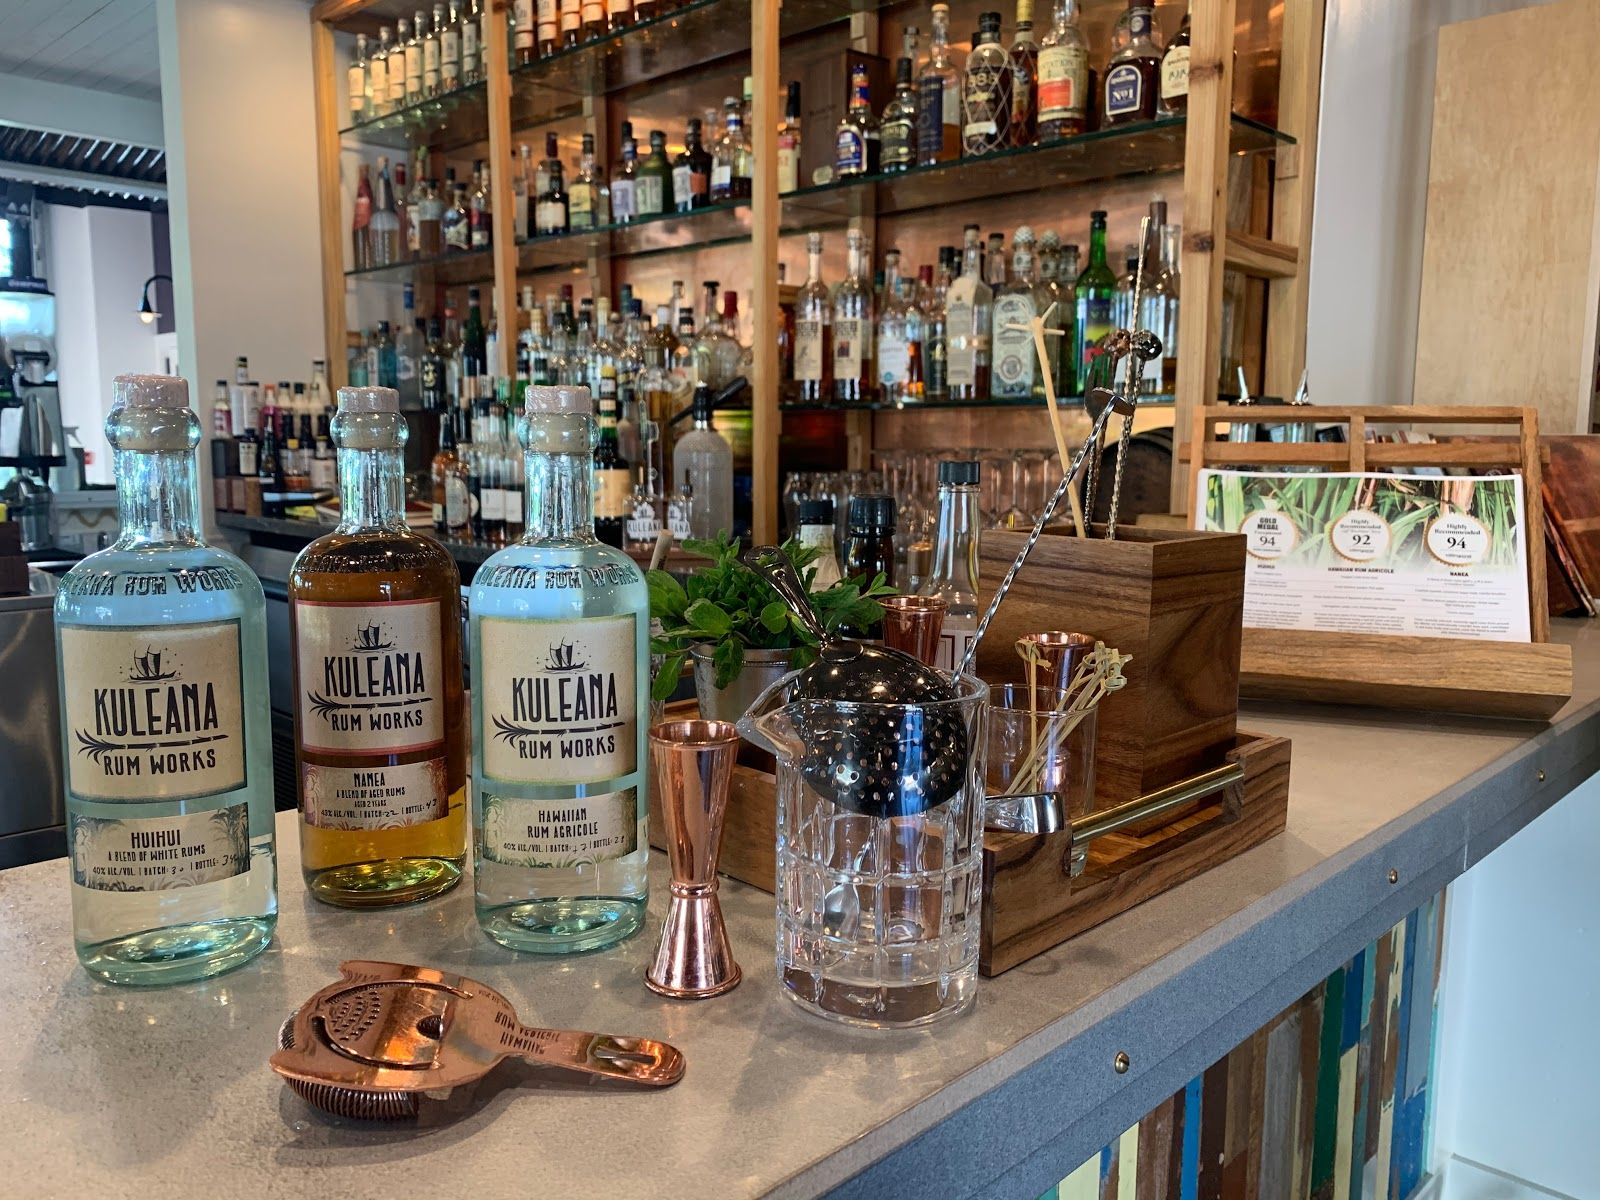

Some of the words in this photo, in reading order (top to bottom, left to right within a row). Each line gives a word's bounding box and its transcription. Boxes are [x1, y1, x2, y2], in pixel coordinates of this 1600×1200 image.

[1257, 523, 1278, 531] MEDAL
[1434, 528, 1481, 536] Recommended
[1259, 535, 1276, 546] 94
[1352, 534, 1371, 546] 92
[1446, 536, 1466, 549] 94
[324, 652, 426, 698] KULEANA
[512, 672, 619, 723] KULEANA
[94, 682, 219, 738] KULEANA
[331, 713, 362, 732] RUM
[370, 709, 423, 731] WORKS
[519, 739, 552, 760] RUM
[560, 735, 616, 759] WORKS
[104, 755, 140, 776] RUM
[150, 748, 217, 775] WORKS
[386, 786, 406, 797] RUMS
[538, 808, 588, 823] HAWAIIAN
[527, 825, 549, 839] RUM
[553, 821, 599, 839] AGRICOLE
[131, 829, 181, 849] HUIHUI
[503, 842, 516, 851] 40%
[115, 851, 136, 862] BLEND
[139, 850, 147, 861] OF
[150, 848, 178, 861] WHITE
[181, 844, 206, 857] RUMS
[93, 866, 105, 875] 40%
